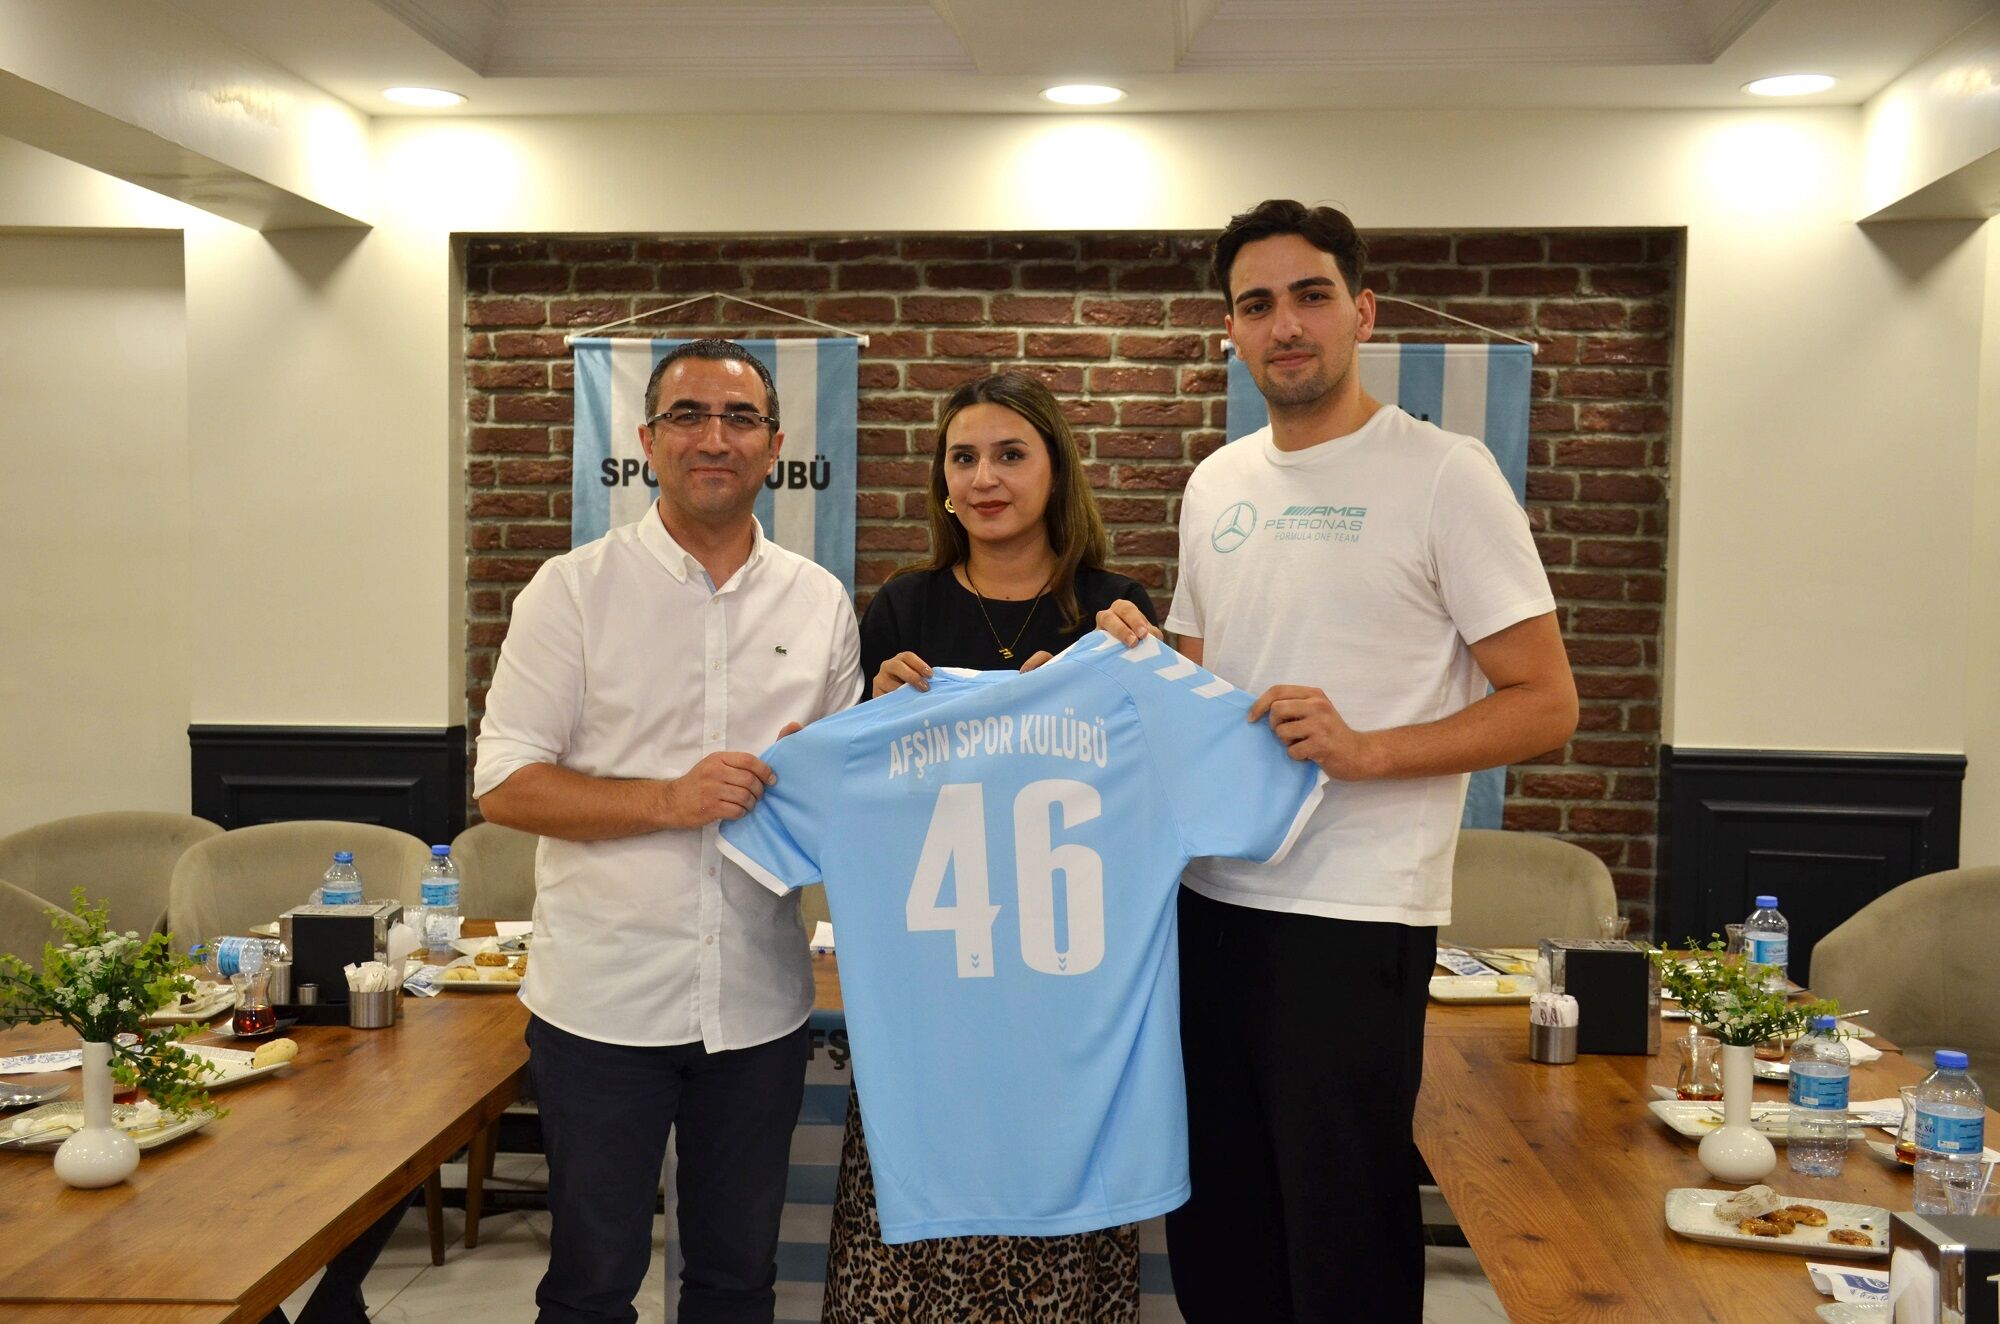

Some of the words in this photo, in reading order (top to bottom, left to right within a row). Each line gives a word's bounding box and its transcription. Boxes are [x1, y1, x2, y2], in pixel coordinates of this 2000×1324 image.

[601, 457, 660, 488] SPO
[1308, 506, 1367, 518] AMG
[1264, 518, 1364, 532] PETRONAS
[1275, 531, 1312, 542] FORMULA
[1314, 532, 1332, 542] ONE
[1335, 532, 1360, 543] TEAM
[888, 719, 950, 780] AFŞİN
[954, 715, 1014, 760] SPOR
[1019, 707, 1108, 769] KULÜBÜ
[905, 778, 1106, 979] 46
